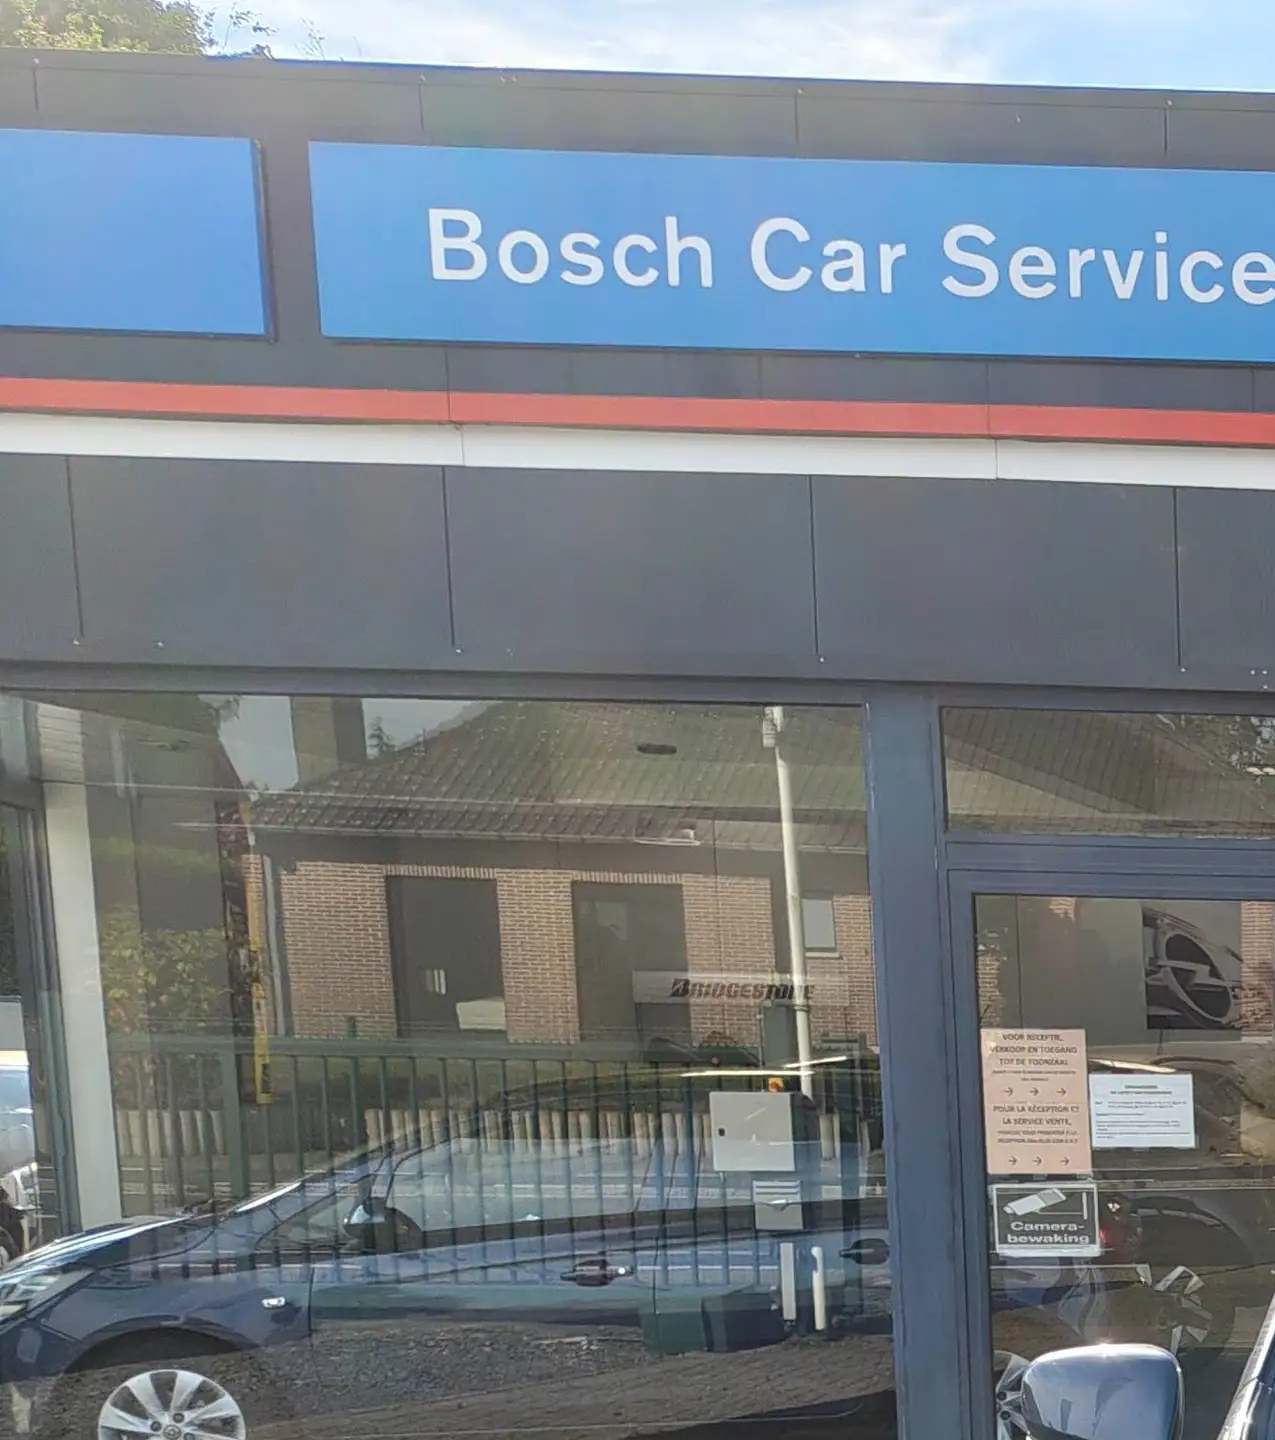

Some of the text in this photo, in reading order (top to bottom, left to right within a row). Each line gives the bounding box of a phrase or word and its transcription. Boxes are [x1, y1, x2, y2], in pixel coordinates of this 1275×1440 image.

[428, 207, 713, 287] Bosch
[750, 216, 907, 294] Car
[1010, 1221, 1085, 1231] Camera-
[1007, 1234, 1090, 1245] bewaking
